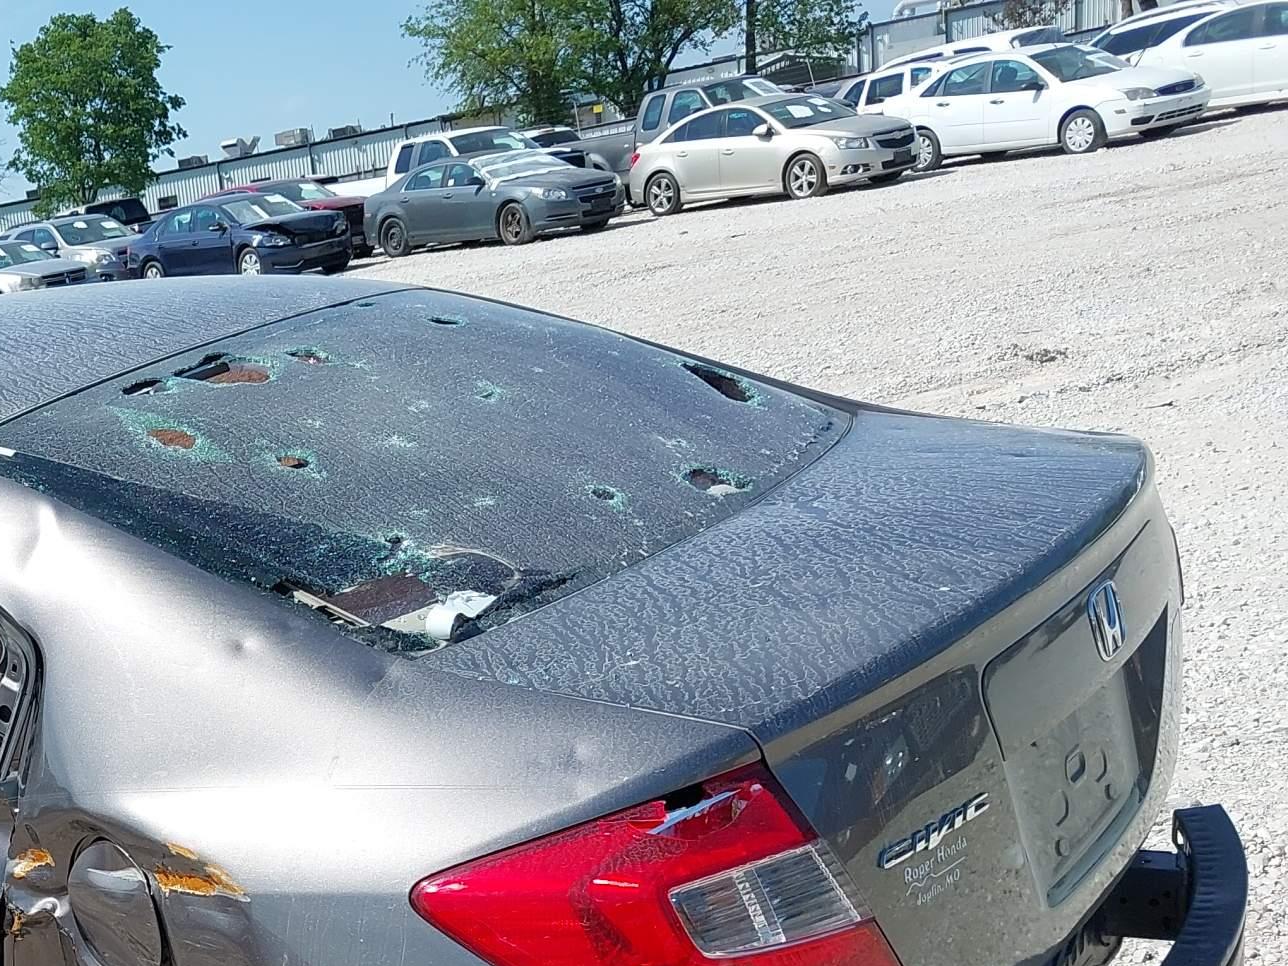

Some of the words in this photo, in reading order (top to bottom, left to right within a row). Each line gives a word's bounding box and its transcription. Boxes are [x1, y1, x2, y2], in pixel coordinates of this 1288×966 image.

[904, 857, 935, 884] Roper
[937, 835, 968, 862] Honda
[945, 868, 961, 889] MO
